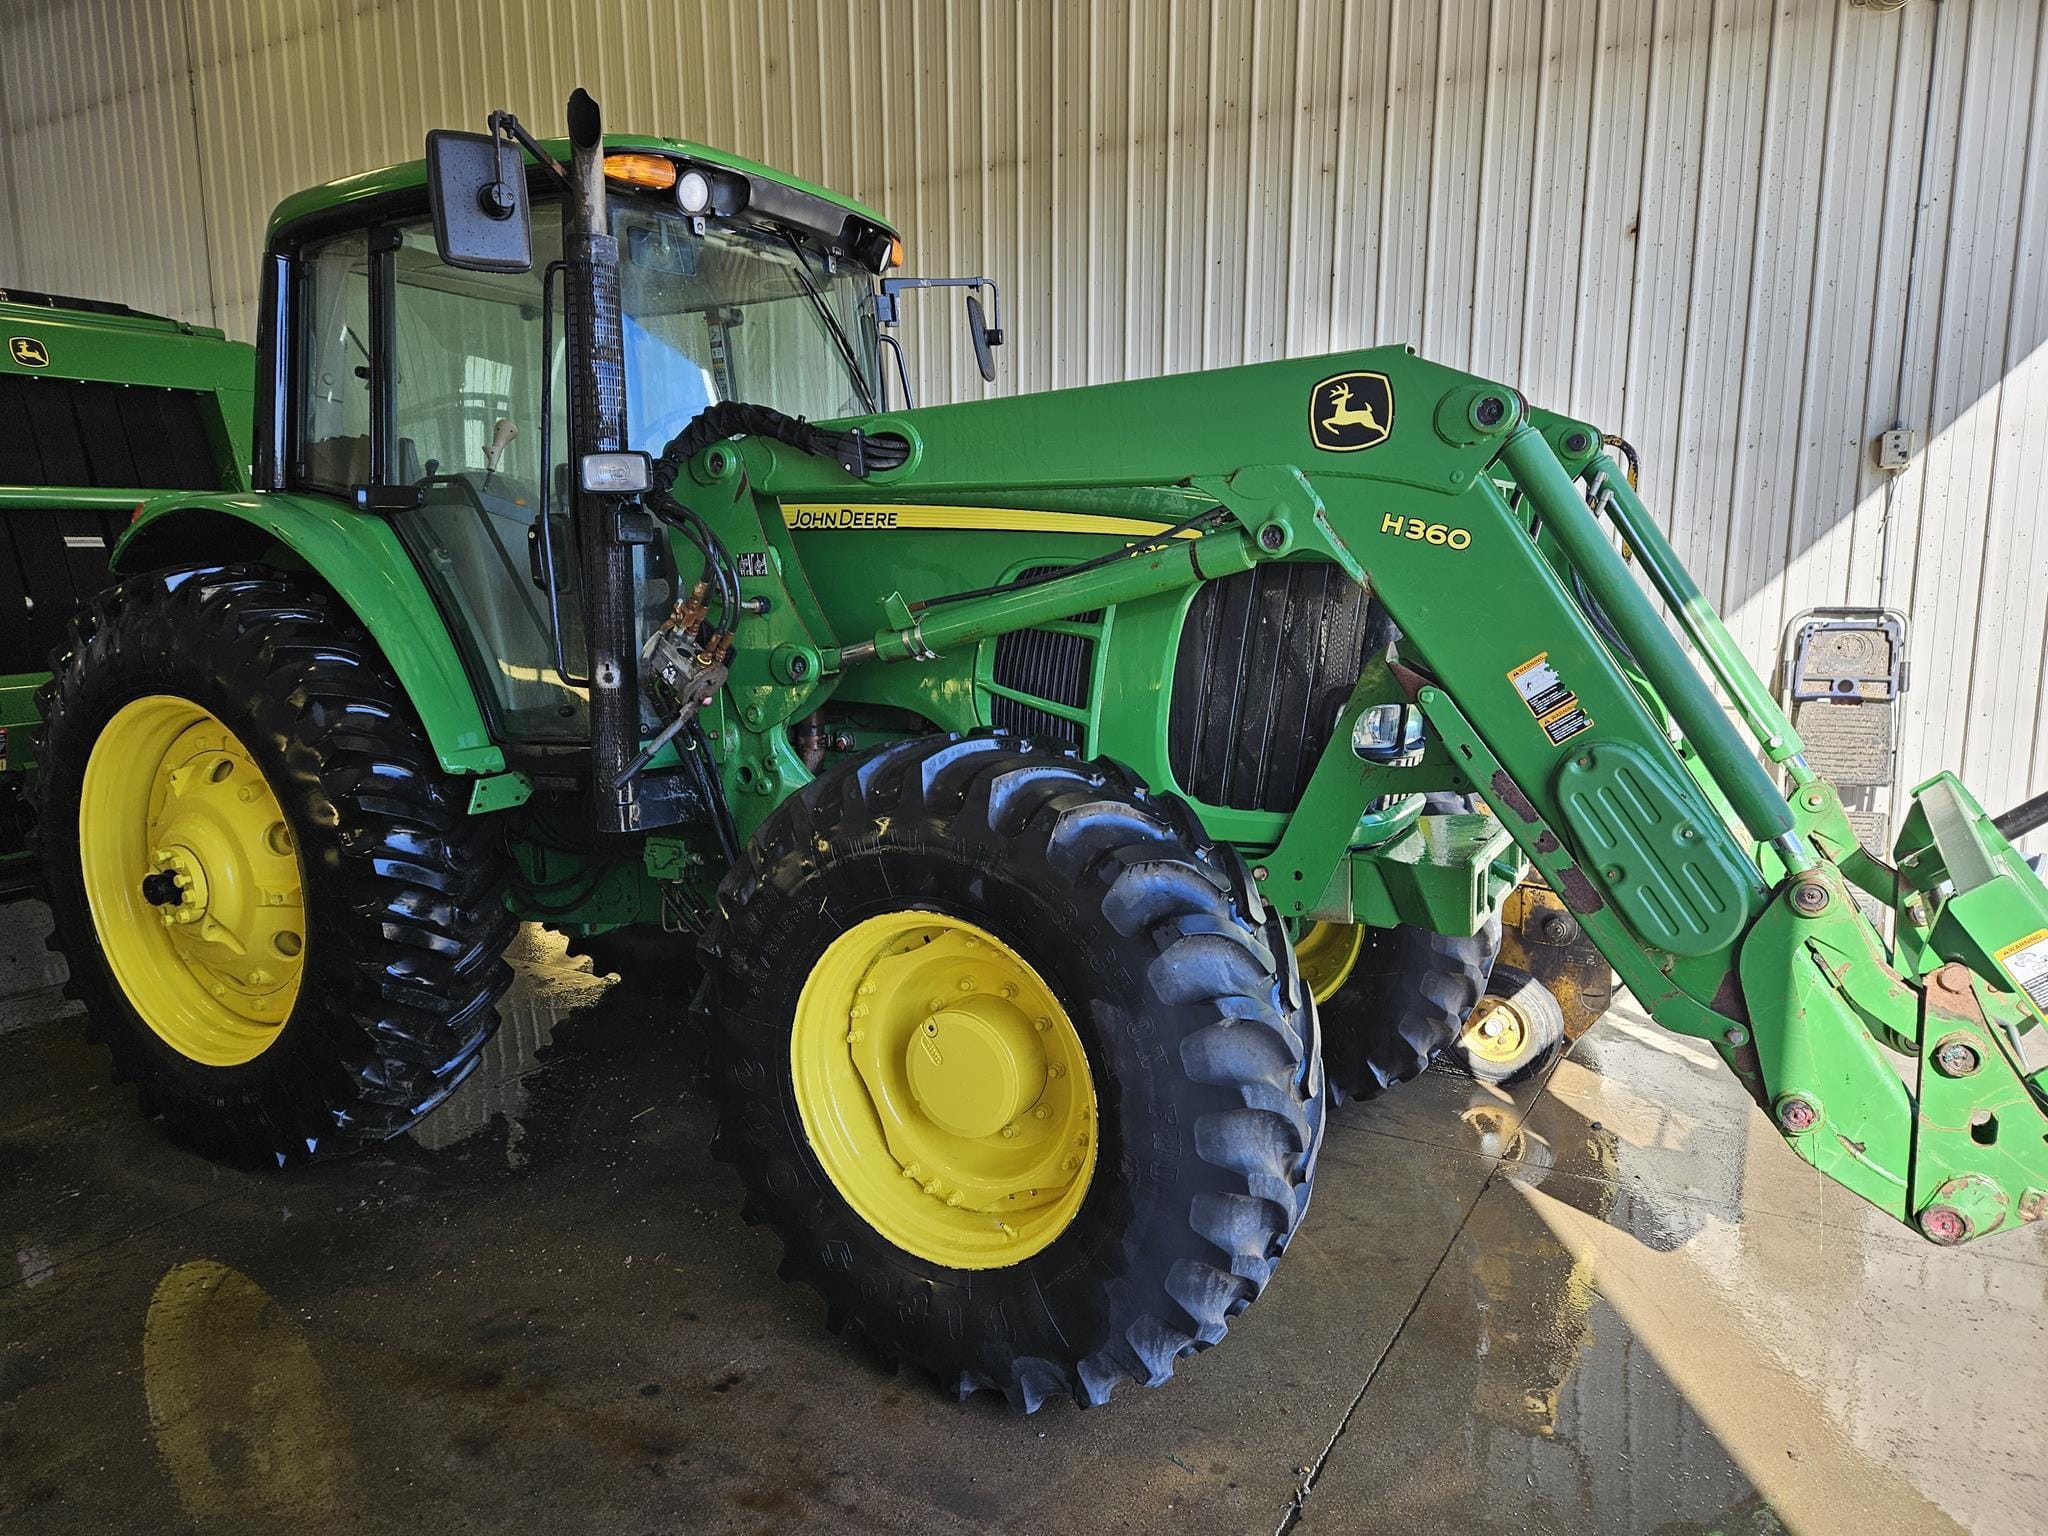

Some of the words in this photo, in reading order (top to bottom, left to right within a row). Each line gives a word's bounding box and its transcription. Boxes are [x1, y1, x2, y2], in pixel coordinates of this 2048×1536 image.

[789, 508, 838, 528] JOHN
[838, 508, 898, 528] DEERE
[1380, 512, 1473, 550] H360
[1518, 656, 1544, 673] WARNING
[2006, 933, 2042, 955] WARNING
